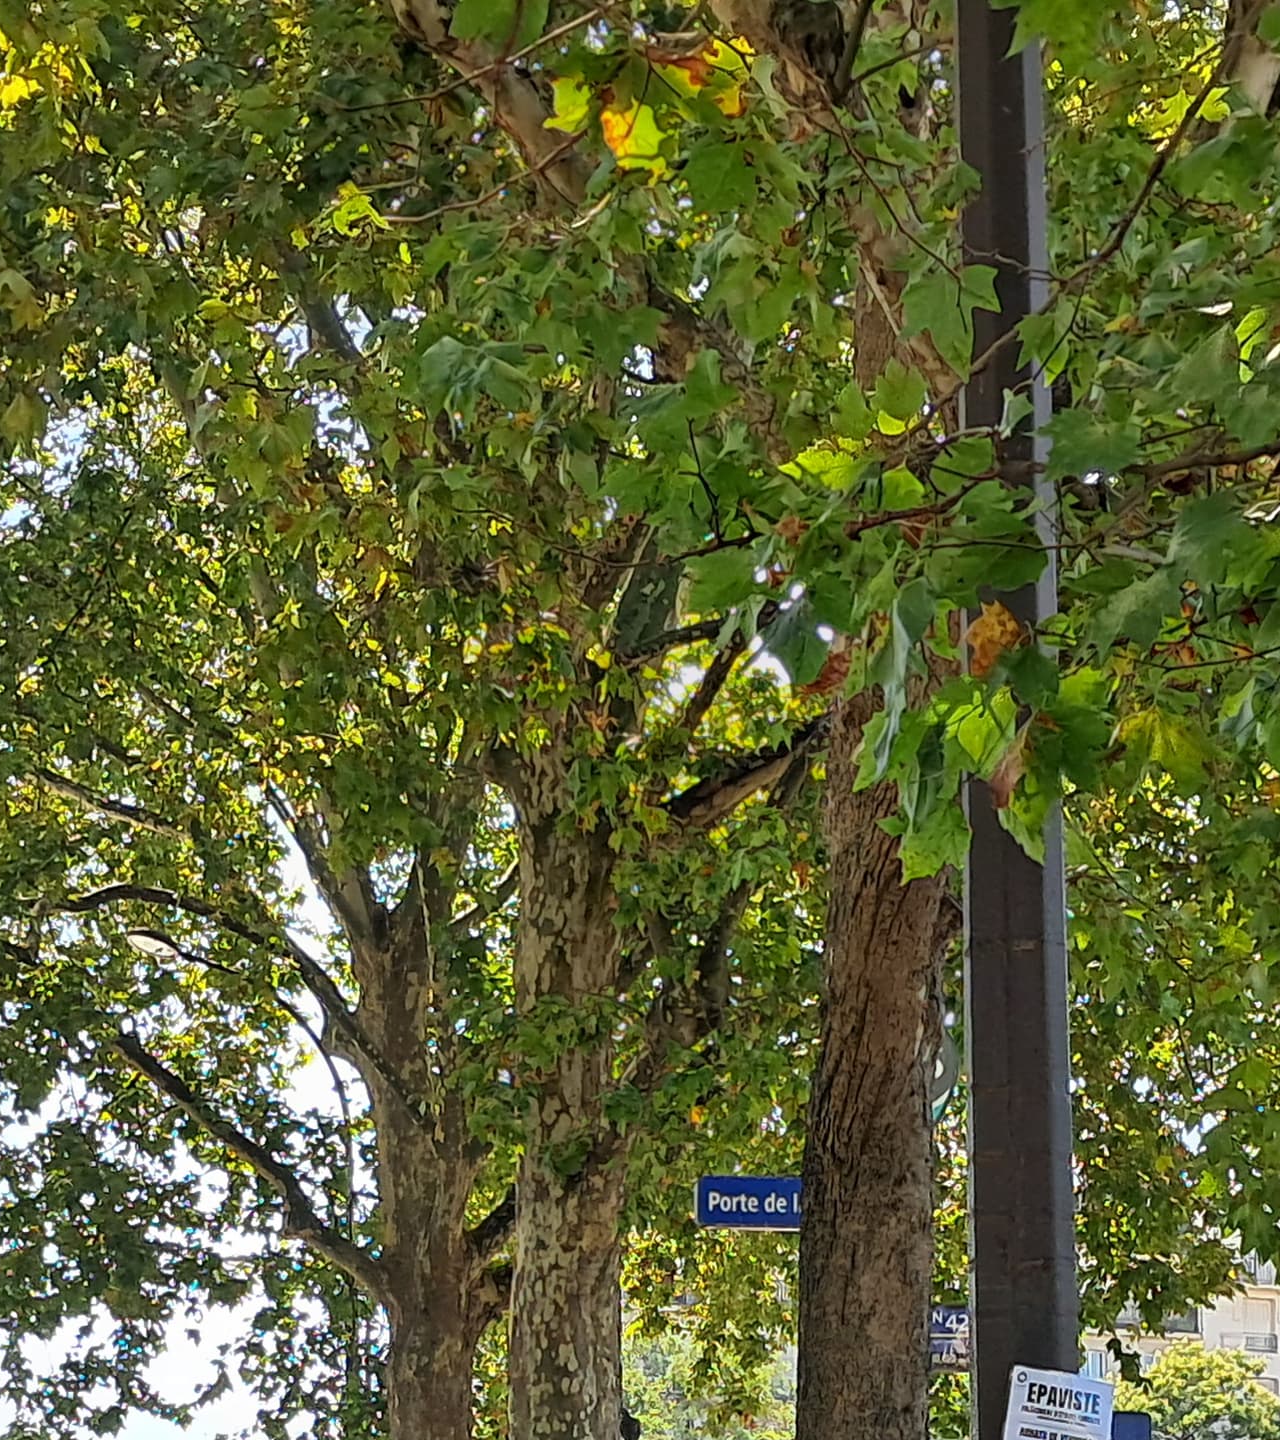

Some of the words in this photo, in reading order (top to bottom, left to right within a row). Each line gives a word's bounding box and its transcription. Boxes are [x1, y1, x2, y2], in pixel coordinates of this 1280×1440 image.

[708, 1191, 760, 1213] Porte
[764, 1191, 788, 1213] de
[793, 1192, 802, 1213] l
[1027, 1382, 1101, 1415] EPAVISTE
